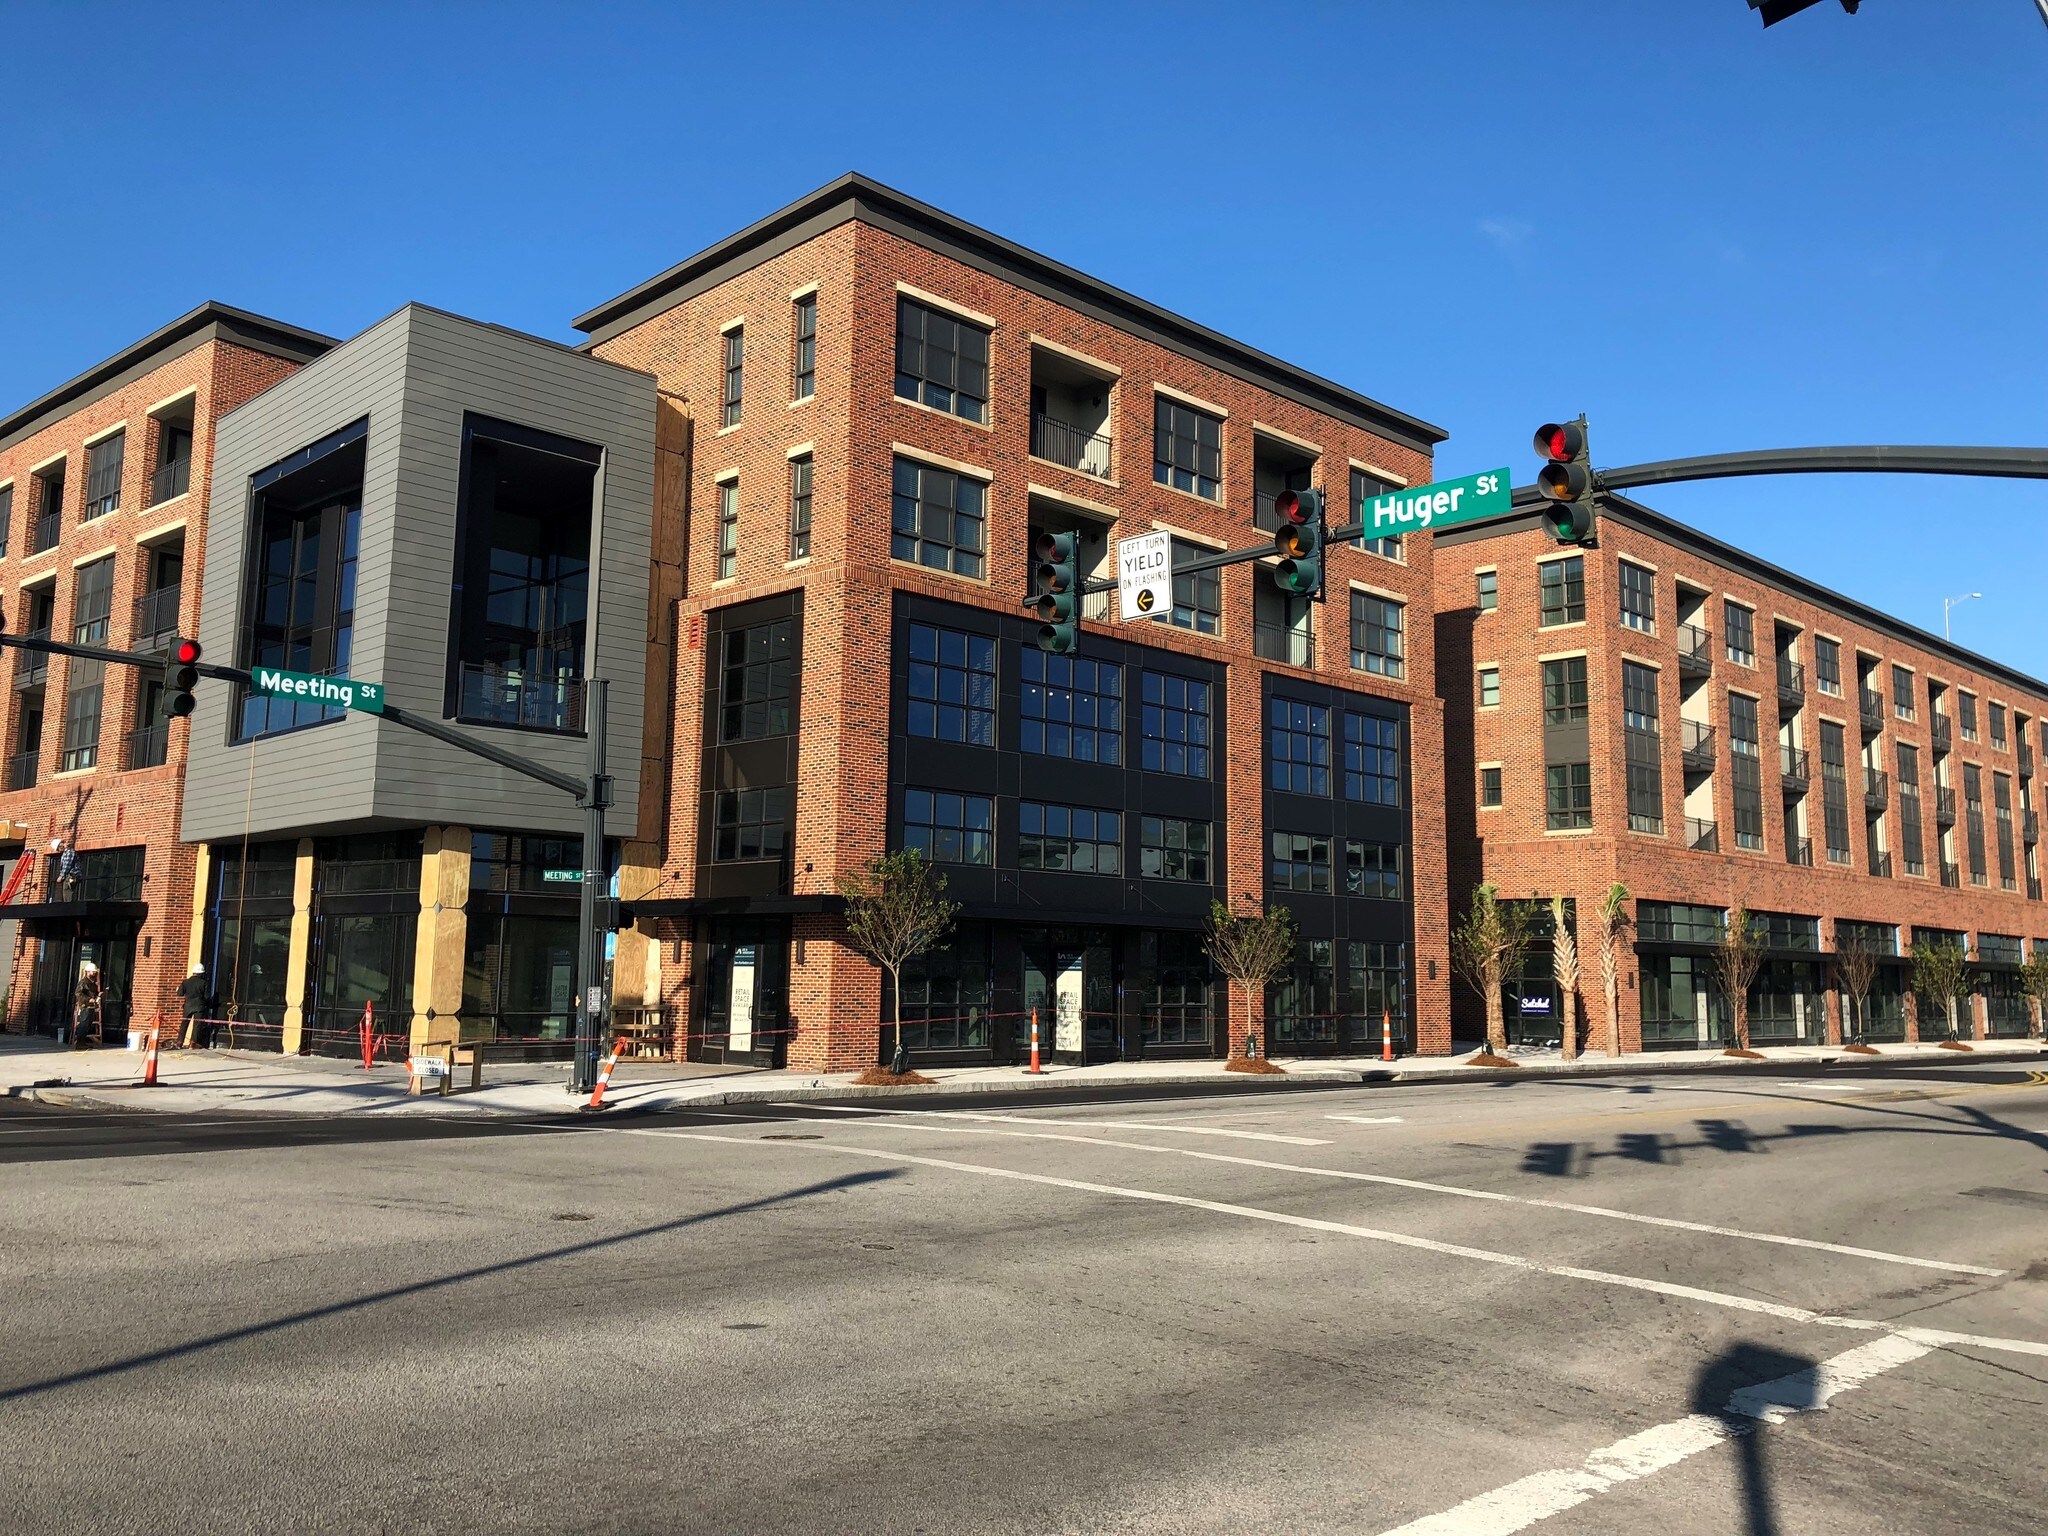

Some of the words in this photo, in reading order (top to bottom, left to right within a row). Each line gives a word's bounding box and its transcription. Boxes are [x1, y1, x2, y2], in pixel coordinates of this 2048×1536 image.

[1374, 487, 1464, 527] Huger
[1475, 474, 1499, 496] St
[1122, 541, 1140, 555] LEFT
[1145, 536, 1165, 550] TURN
[1125, 551, 1164, 573] YIELD
[1122, 579, 1132, 590] ON
[1134, 570, 1167, 586] FLASHING
[260, 670, 352, 707] Meeting
[361, 685, 376, 699] St
[544, 871, 573, 880] MEETING
[1060, 991, 1078, 999] RETAIL
[416, 1058, 442, 1066] SIDEWALK
[418, 1066, 439, 1074] CLOSED
